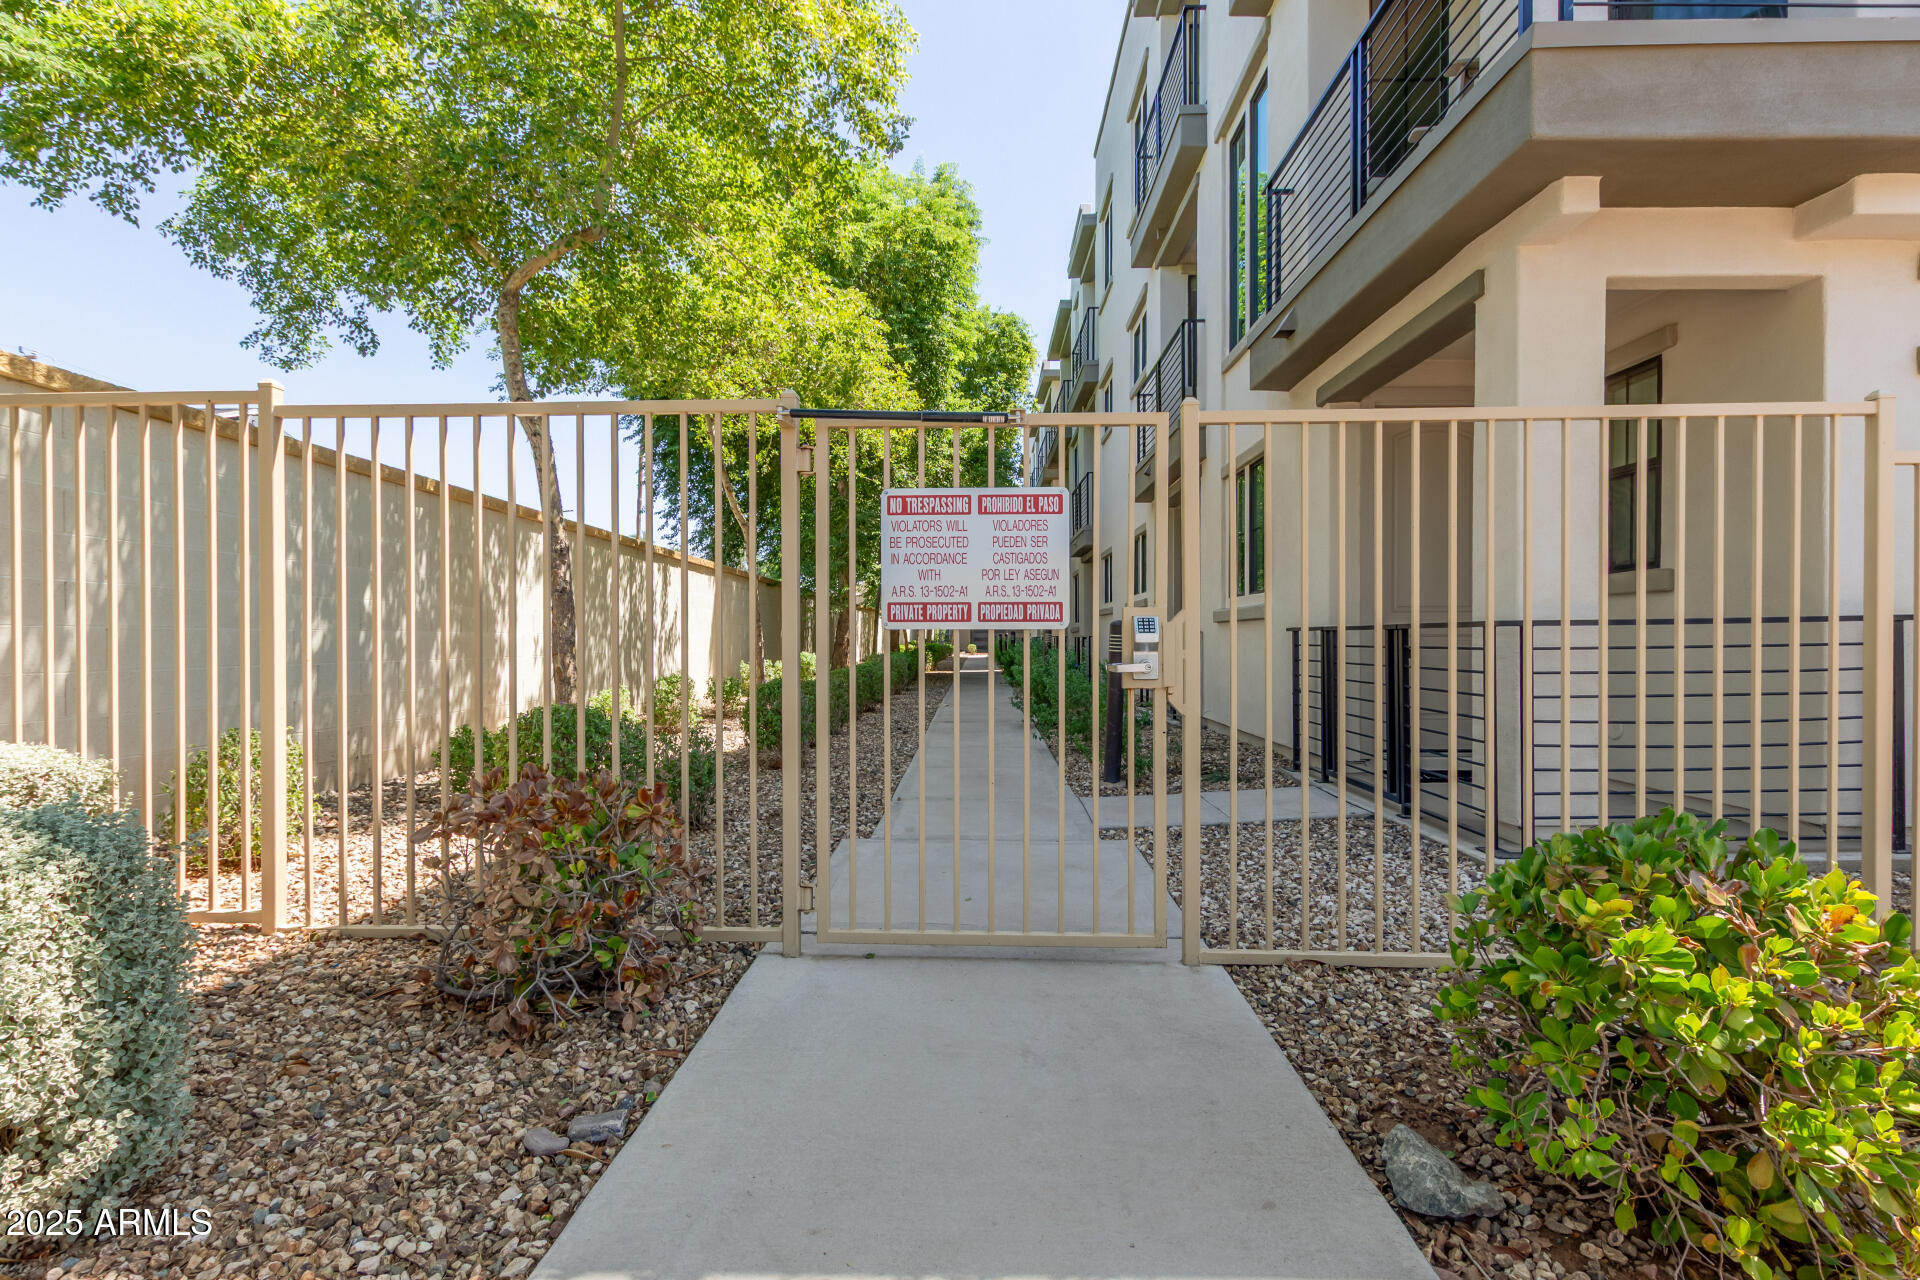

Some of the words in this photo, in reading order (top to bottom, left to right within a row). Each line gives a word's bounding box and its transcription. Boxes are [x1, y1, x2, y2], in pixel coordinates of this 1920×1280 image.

[890, 498, 902, 513] NO
[906, 497, 969, 513] TRESPASSING
[982, 497, 1022, 512] PROHIBIDO
[1026, 497, 1035, 512] EL
[1039, 497, 1059, 512] PASO
[891, 520, 942, 532] VIOLATORS
[947, 520, 968, 531] WILL
[993, 520, 1048, 531] VIOLADORES
[890, 537, 902, 548] BE
[906, 536, 969, 548] PROSECUTED
[993, 536, 1026, 548] PUEDEN
[1030, 536, 1048, 548] SER
[891, 553, 899, 564] IN
[904, 553, 967, 565] ACCORDANCE
[993, 553, 1048, 564] CASTIGADOS
[918, 570, 941, 581] WITH
[982, 570, 999, 580] POR
[1003, 570, 1020, 580] LEY
[1024, 569, 1059, 580] ASEGUN
[921, 586, 968, 597] 13-1502-A1
[1012, 585, 1056, 597] 13-1502-A1
[891, 605, 923, 620] PRIVATE
[927, 604, 968, 620] PROPERTY
[980, 605, 1024, 620] PROPIEDAD
[1027, 604, 1060, 620] PRIVADA
